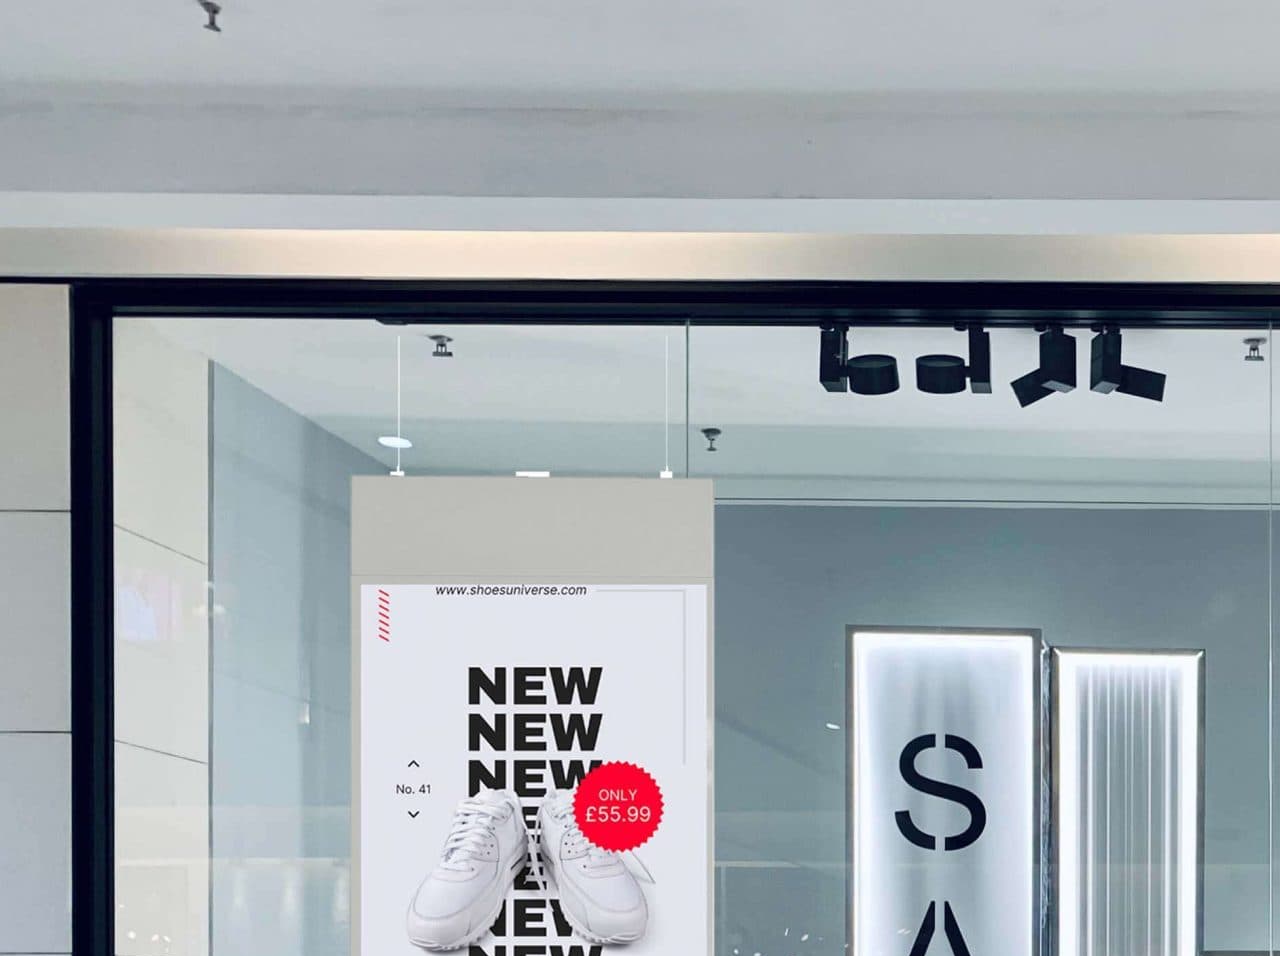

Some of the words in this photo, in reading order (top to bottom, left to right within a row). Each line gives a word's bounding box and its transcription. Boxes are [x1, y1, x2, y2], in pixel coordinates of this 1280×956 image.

[435, 584, 587, 597] www.shoesuniverse.com
[468, 666, 603, 705] NEW
[468, 713, 603, 752] NEW
[396, 783, 415, 795] No.
[419, 783, 431, 795] 41
[598, 789, 637, 802] ONLY
[585, 806, 651, 823] £55.99
